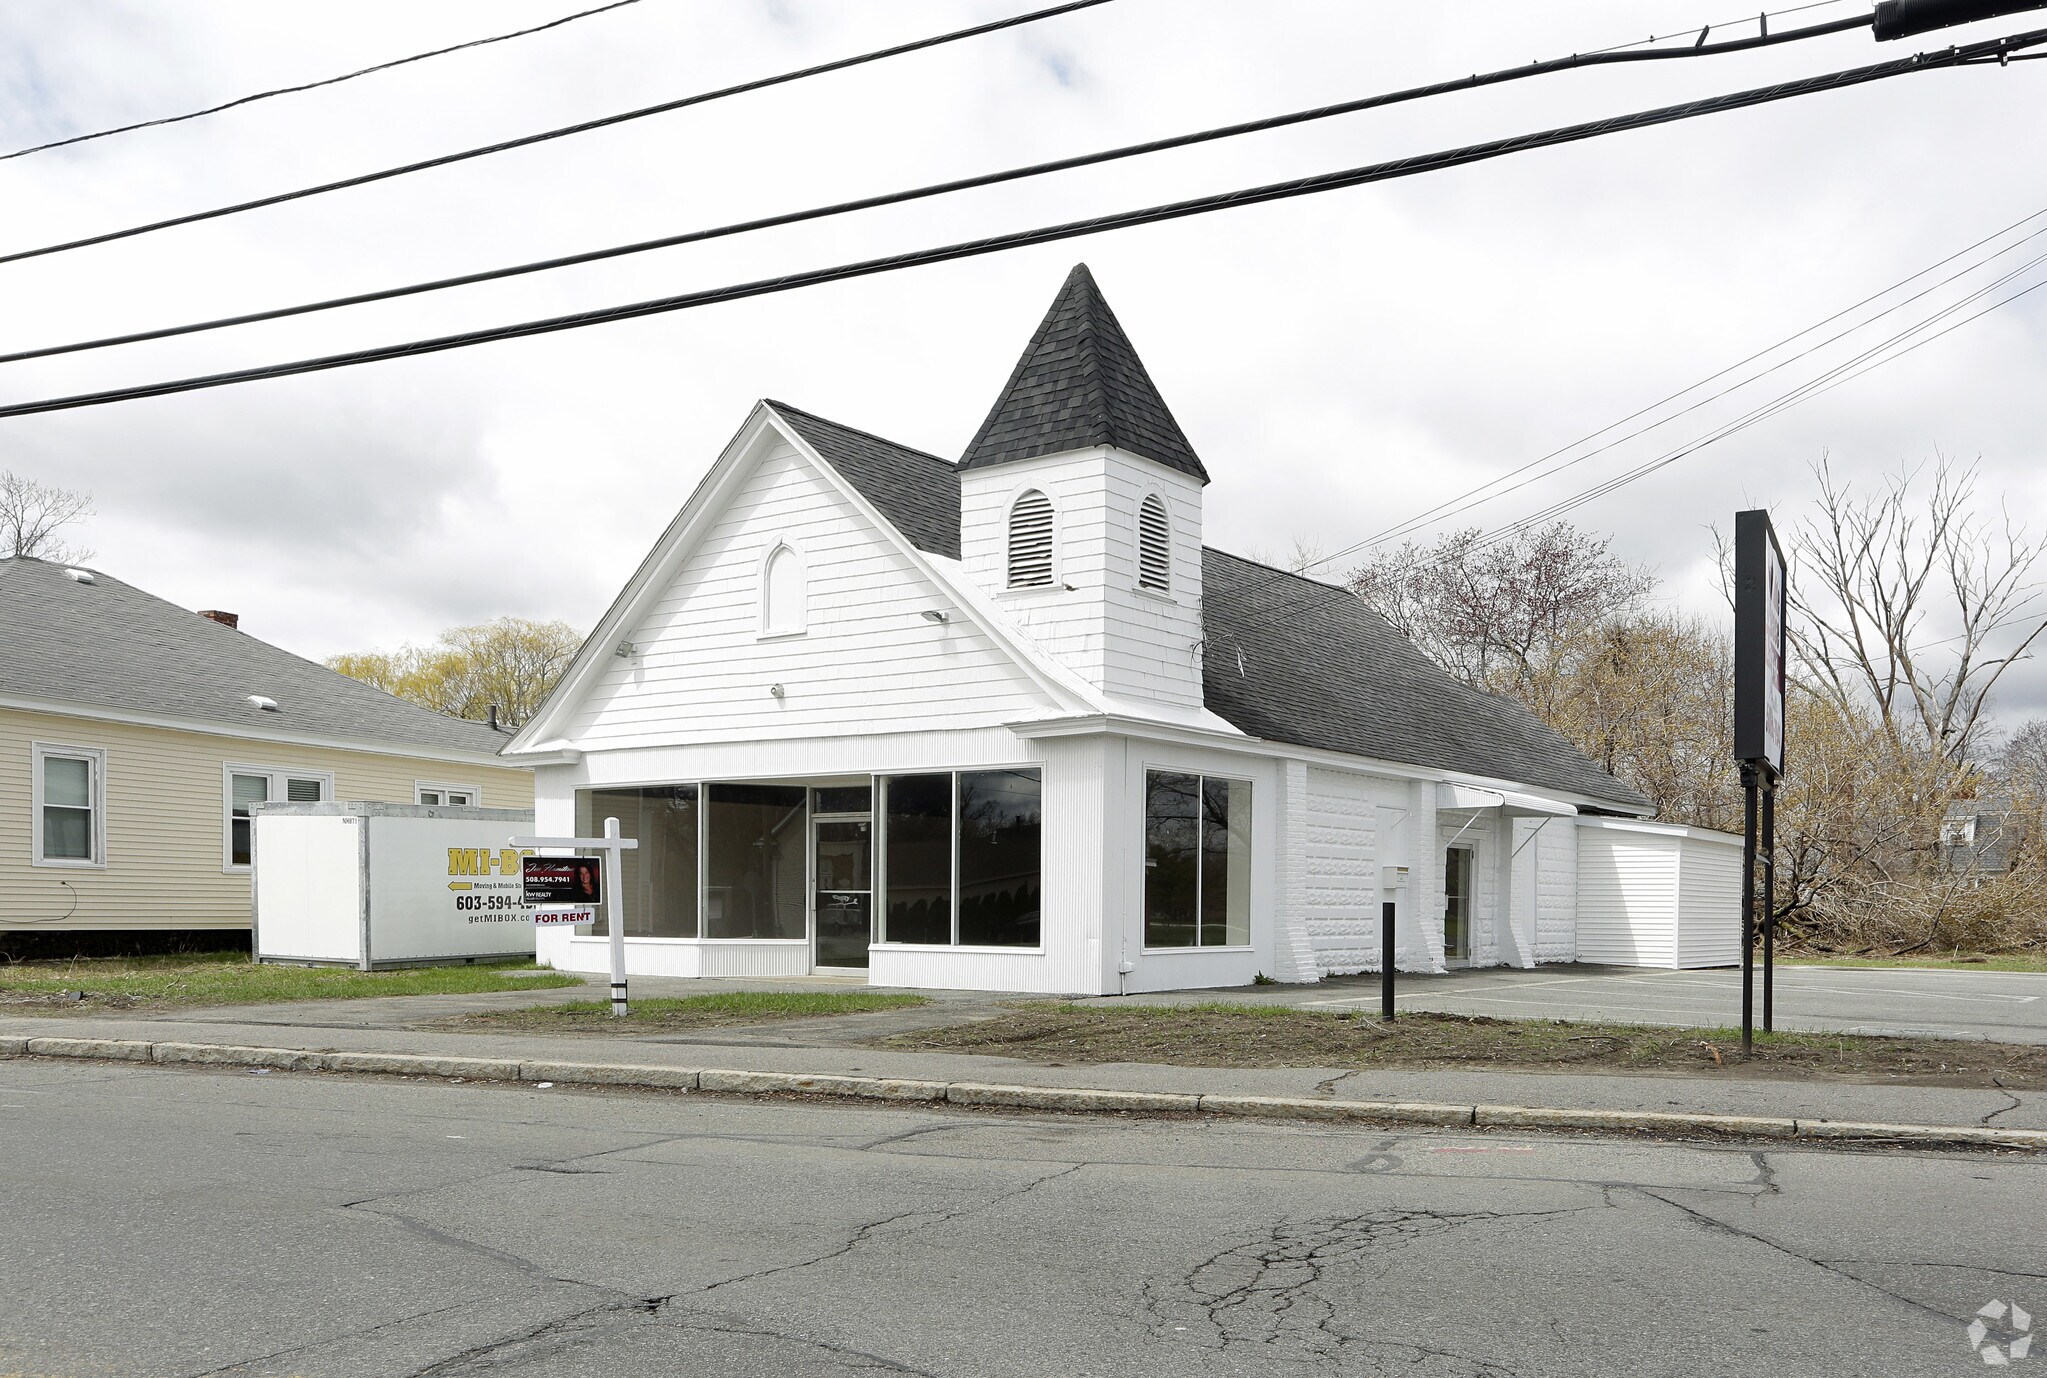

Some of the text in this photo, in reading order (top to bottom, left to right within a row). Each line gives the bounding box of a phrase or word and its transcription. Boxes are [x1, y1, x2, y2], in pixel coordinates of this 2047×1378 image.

[447, 848, 535, 876] MI-B
[473, 882, 493, 890] Moving
[456, 895, 536, 910] 603-594-4
[535, 912, 591, 923] FOR RENT
